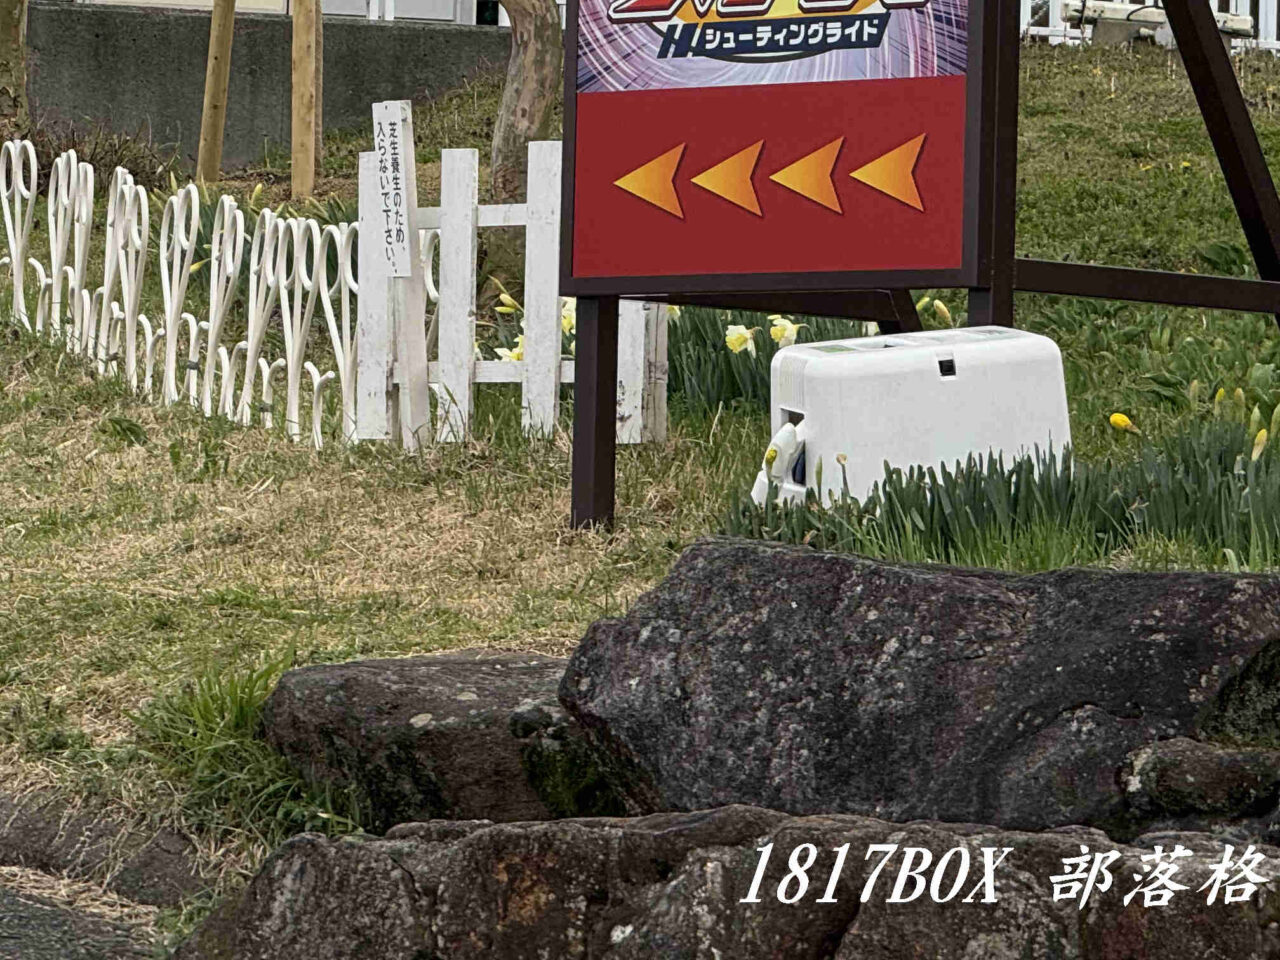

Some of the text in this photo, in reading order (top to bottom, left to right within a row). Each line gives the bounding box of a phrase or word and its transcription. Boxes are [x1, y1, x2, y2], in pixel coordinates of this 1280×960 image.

[704, 19, 879, 50] シューティングライド
